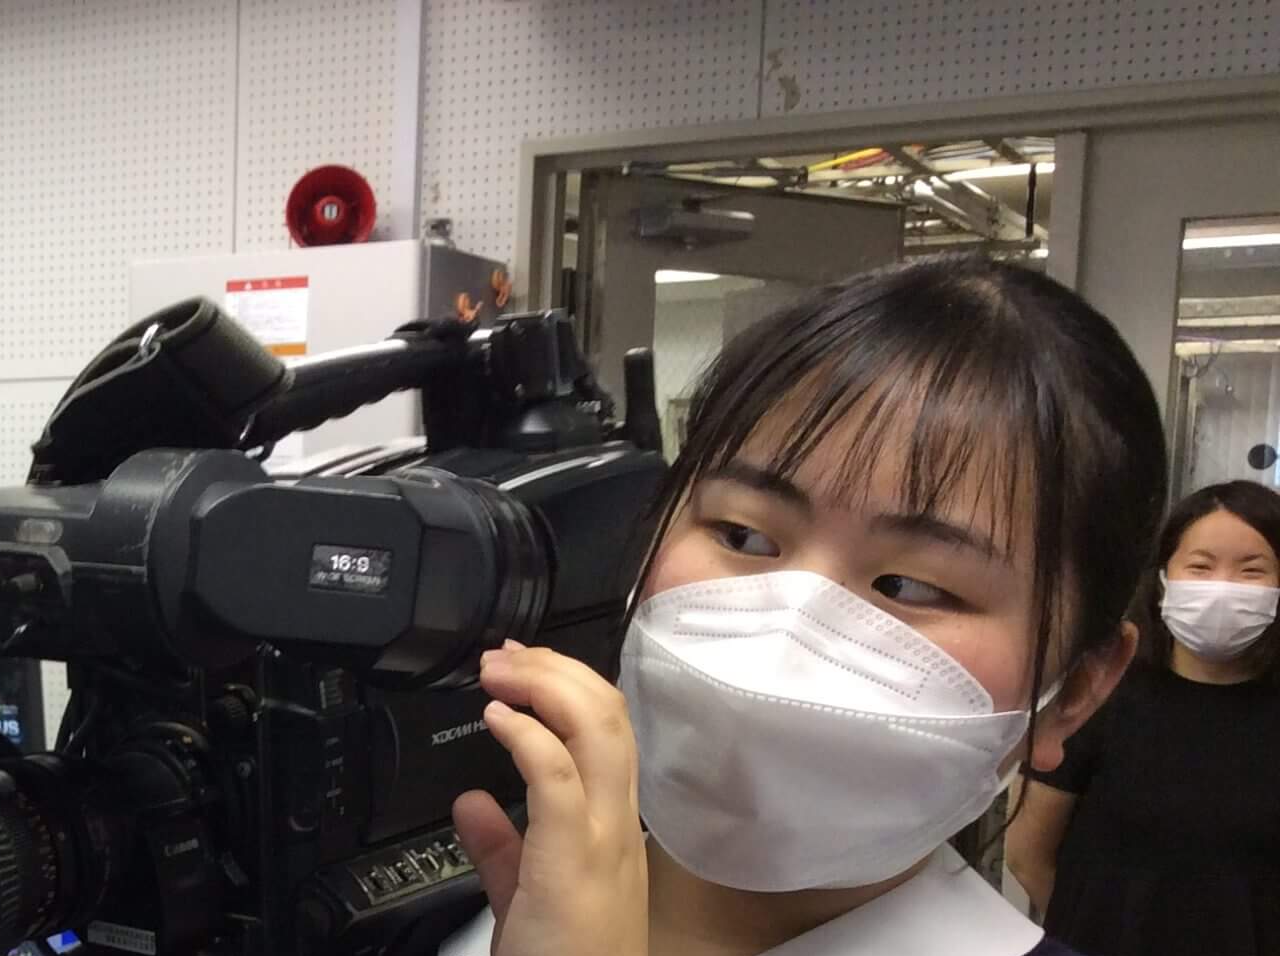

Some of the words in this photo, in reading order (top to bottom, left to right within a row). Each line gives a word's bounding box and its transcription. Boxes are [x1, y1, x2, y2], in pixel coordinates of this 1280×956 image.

[330, 554, 370, 573] 16:9
[431, 722, 473, 746] XDCAM
[473, 719, 489, 733] H
